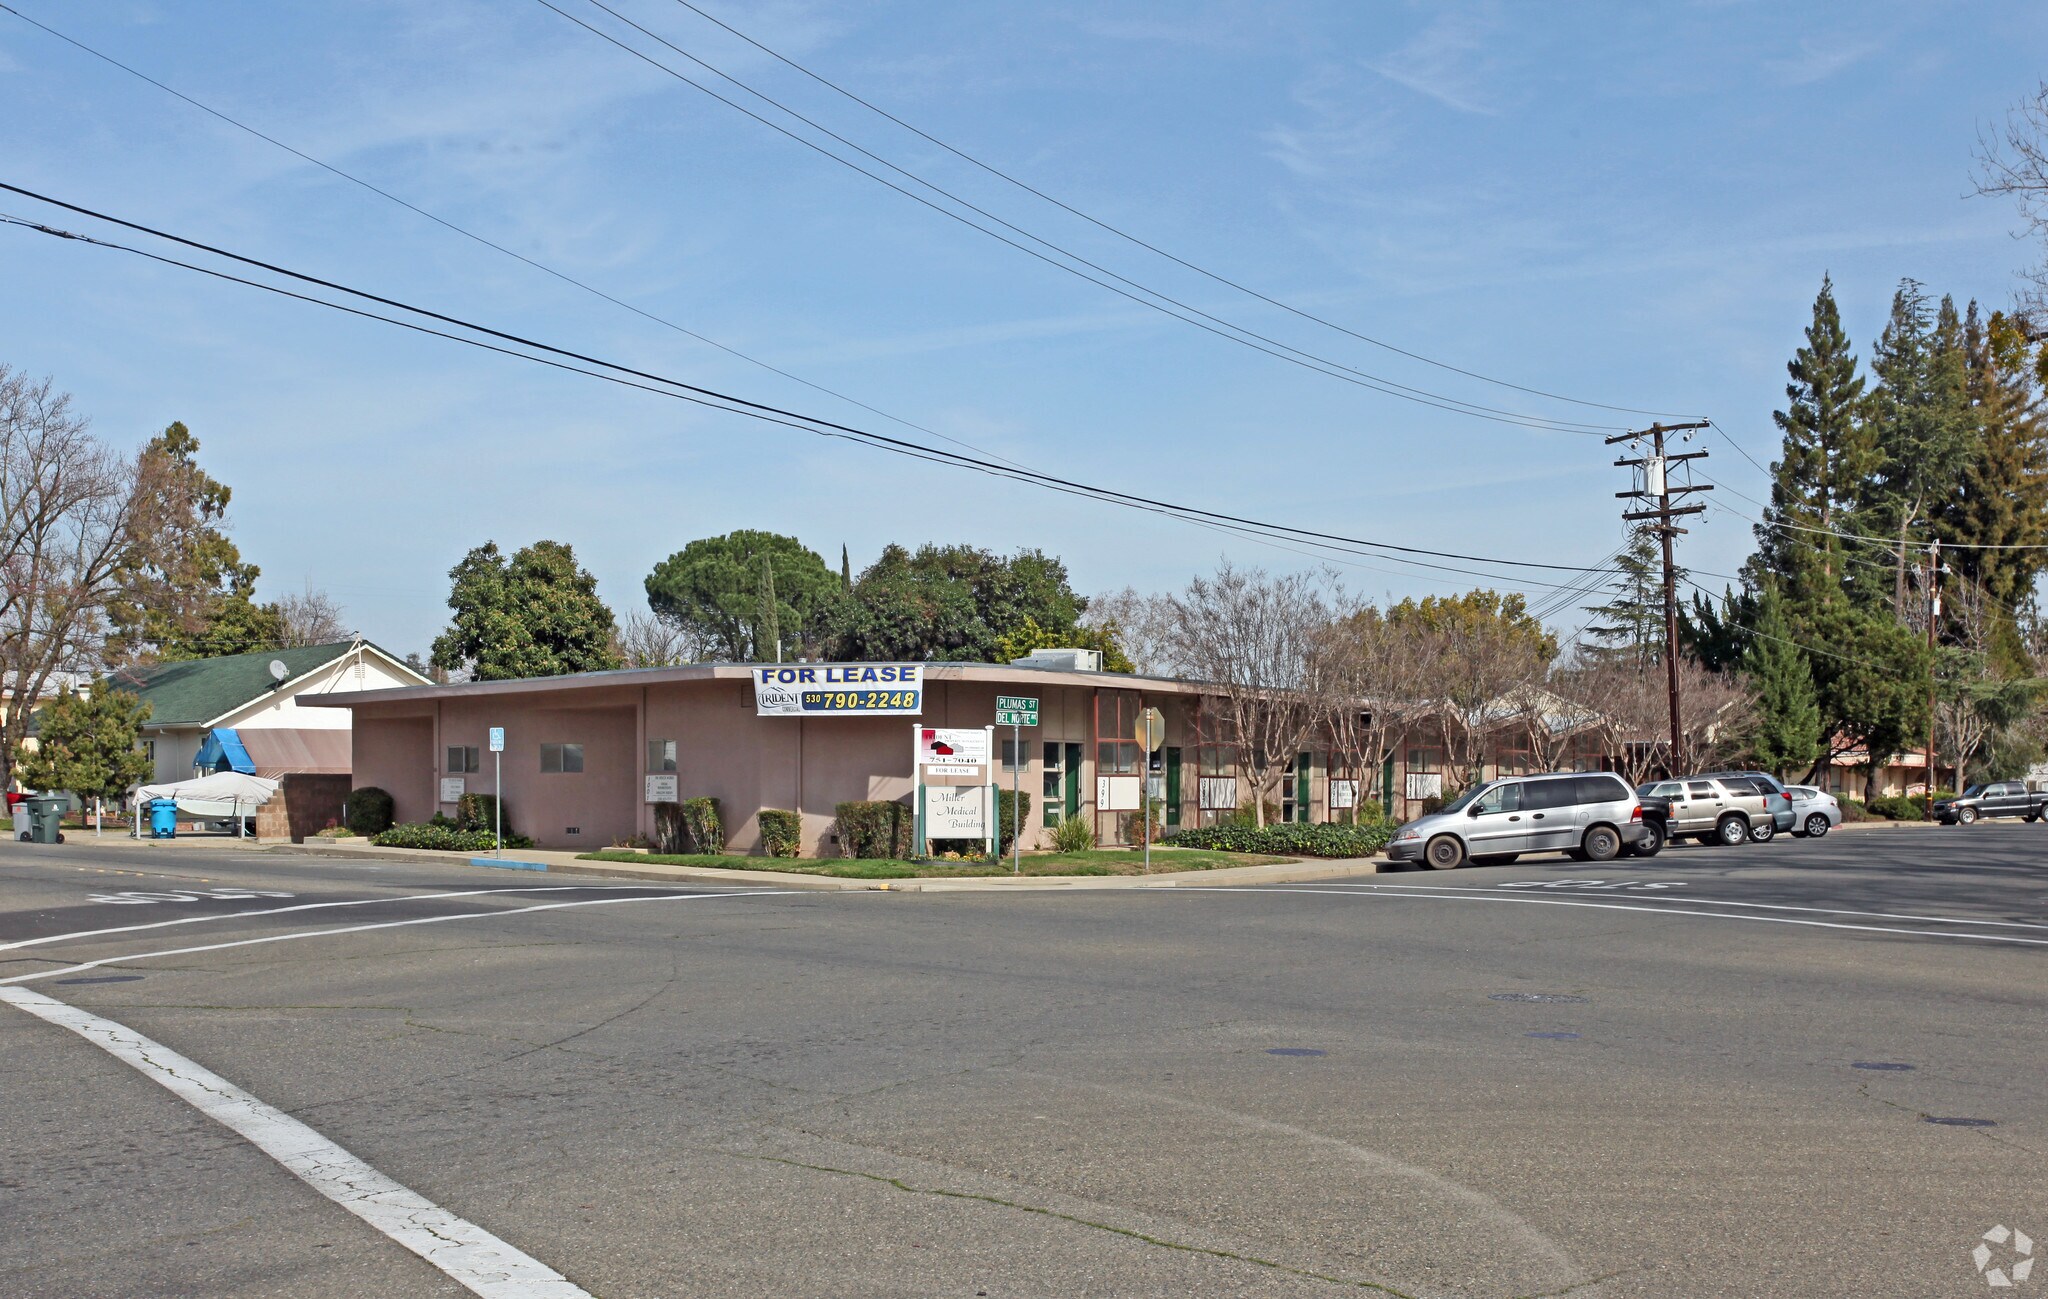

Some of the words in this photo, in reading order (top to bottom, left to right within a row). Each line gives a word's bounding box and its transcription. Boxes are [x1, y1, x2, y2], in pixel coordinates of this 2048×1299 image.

[762, 669, 817, 684] FOR
[826, 667, 916, 683] LEASE
[758, 692, 801, 705] TRIDENT
[805, 694, 821, 703] 530
[824, 692, 915, 708] 790-2248
[999, 698, 1026, 710] PLUMAS
[1029, 700, 1036, 709] ST
[997, 712, 1010, 723] DEL
[1011, 713, 1030, 724] NORTE
[931, 792, 965, 803] Miller
[936, 806, 977, 816] Medical
[948, 819, 986, 831] Building
[1497, 880, 1688, 889] STOP
